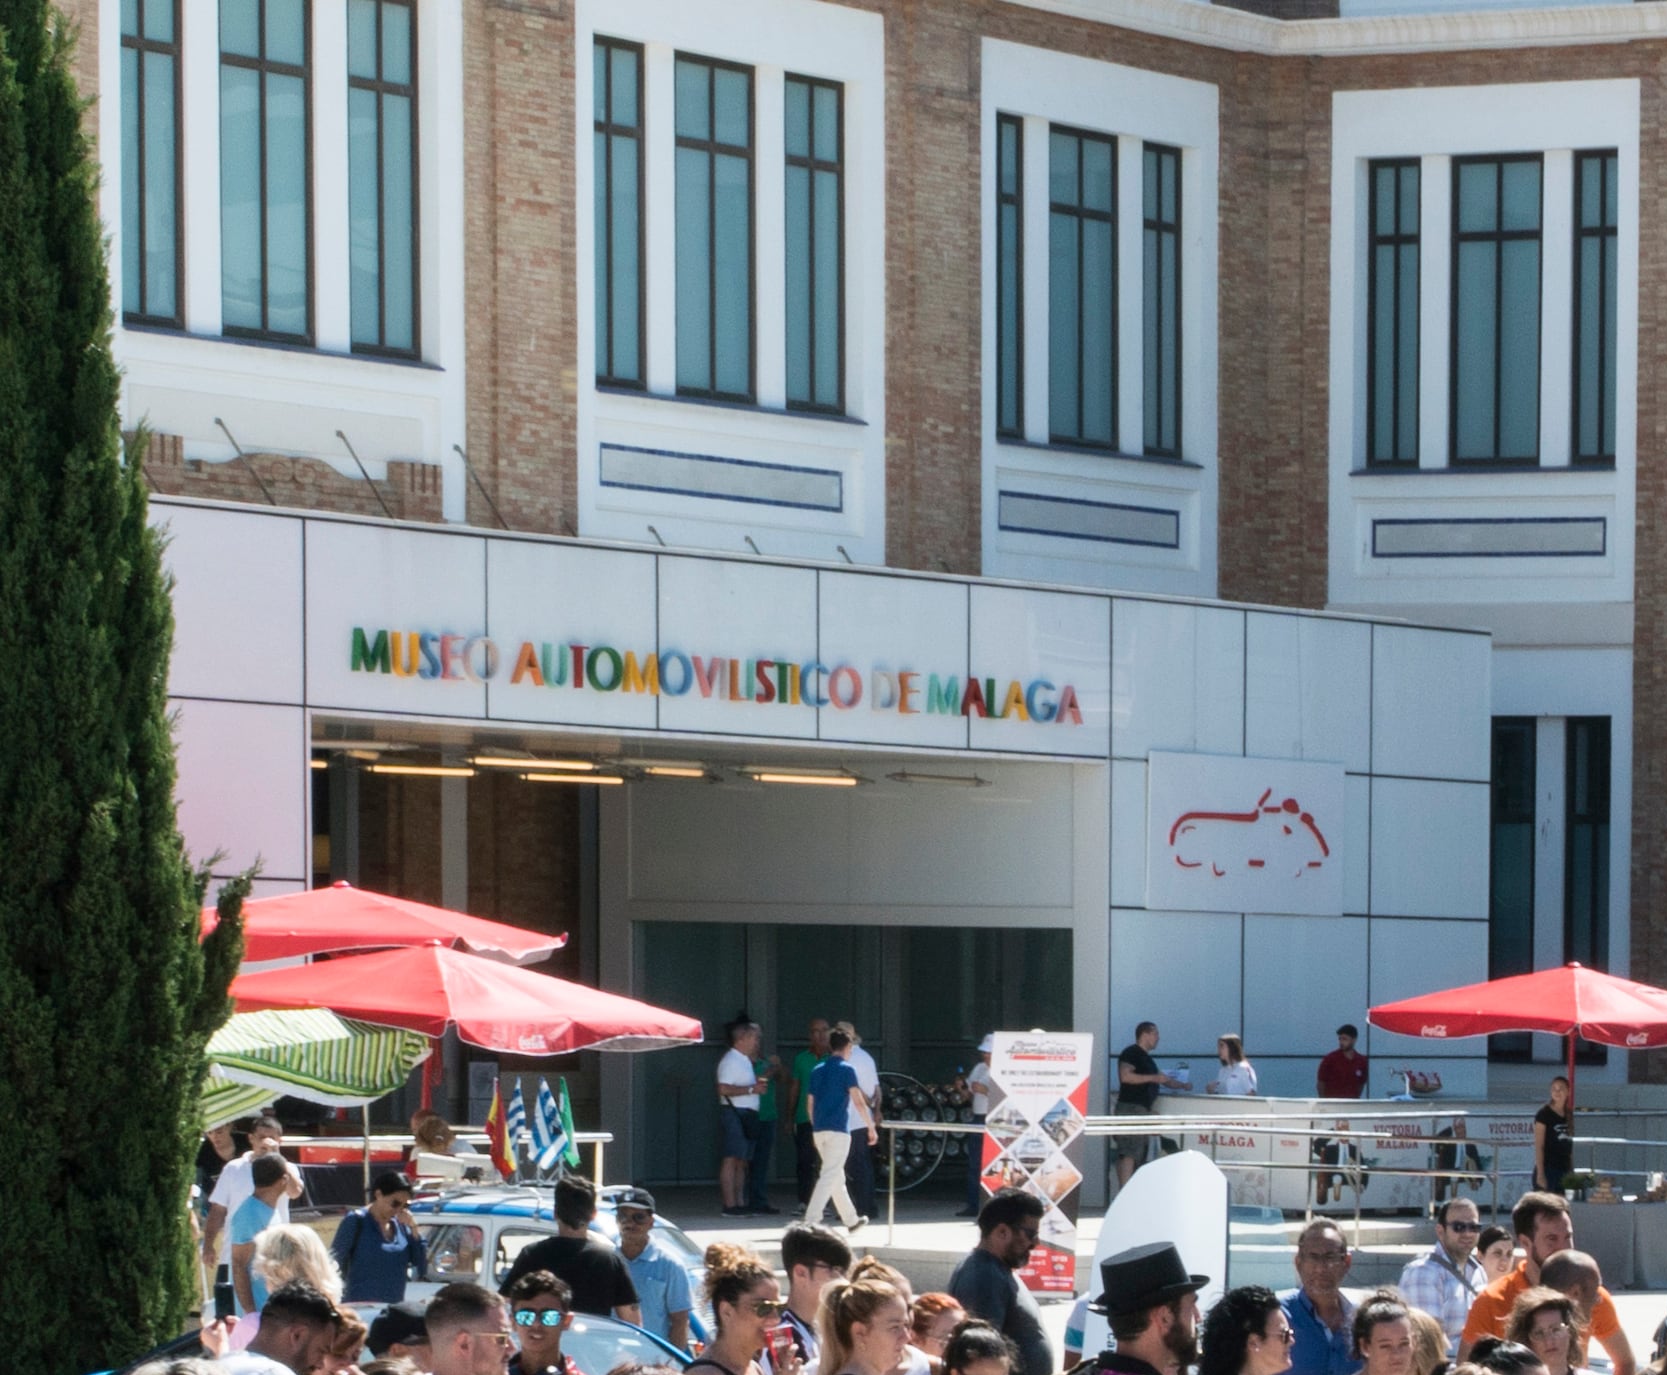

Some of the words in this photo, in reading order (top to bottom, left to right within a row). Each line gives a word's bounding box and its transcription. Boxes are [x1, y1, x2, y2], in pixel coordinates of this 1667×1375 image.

[351, 627, 498, 682] MUSEO
[511, 641, 863, 710] AUTOMOVILISTICO
[871, 666, 920, 714] DE
[927, 673, 1083, 724] MALAGA
[1373, 1124, 1421, 1136] VICTORIA
[1489, 1123, 1535, 1135] VICTORIA
